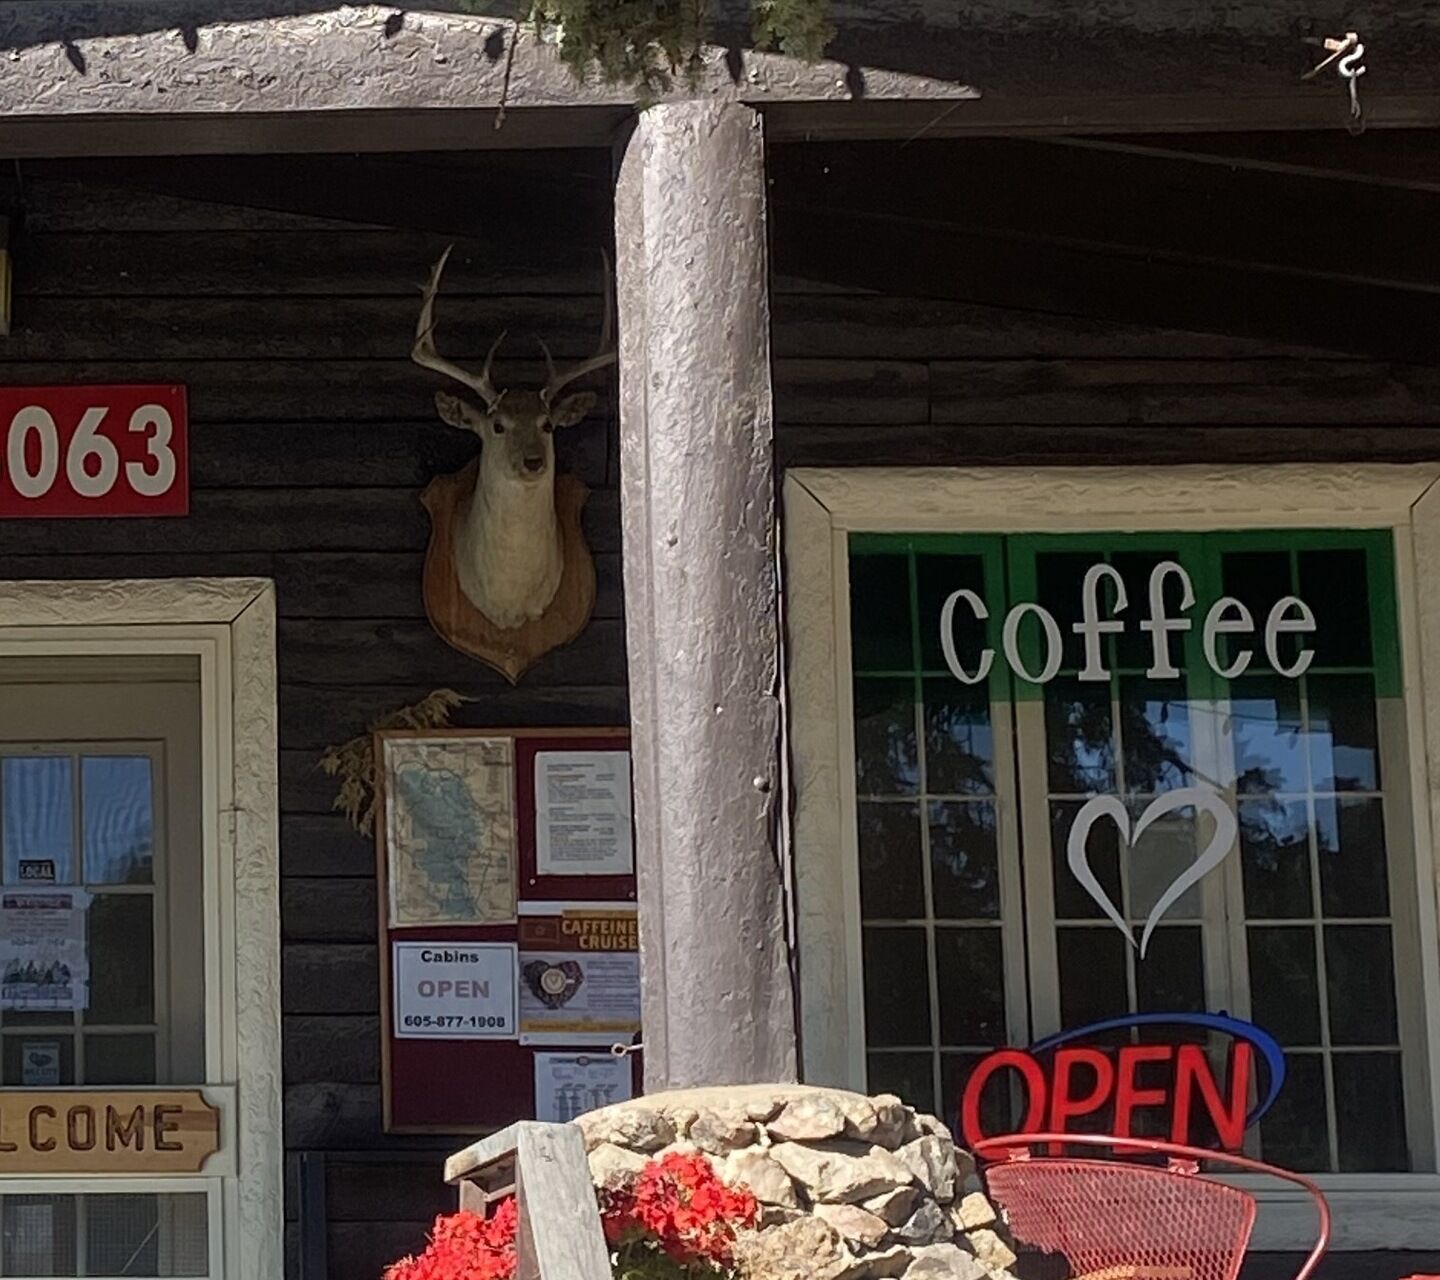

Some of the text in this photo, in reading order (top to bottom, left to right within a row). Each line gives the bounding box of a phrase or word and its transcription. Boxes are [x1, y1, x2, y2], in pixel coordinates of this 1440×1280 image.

[939, 560, 1317, 685] Coffee
[562, 919, 638, 935] CAFFEINE
[579, 935, 638, 950] CRUISE
[421, 950, 480, 964] Cabins
[417, 979, 490, 999] OPEN
[962, 1041, 1252, 1160] OPEN
